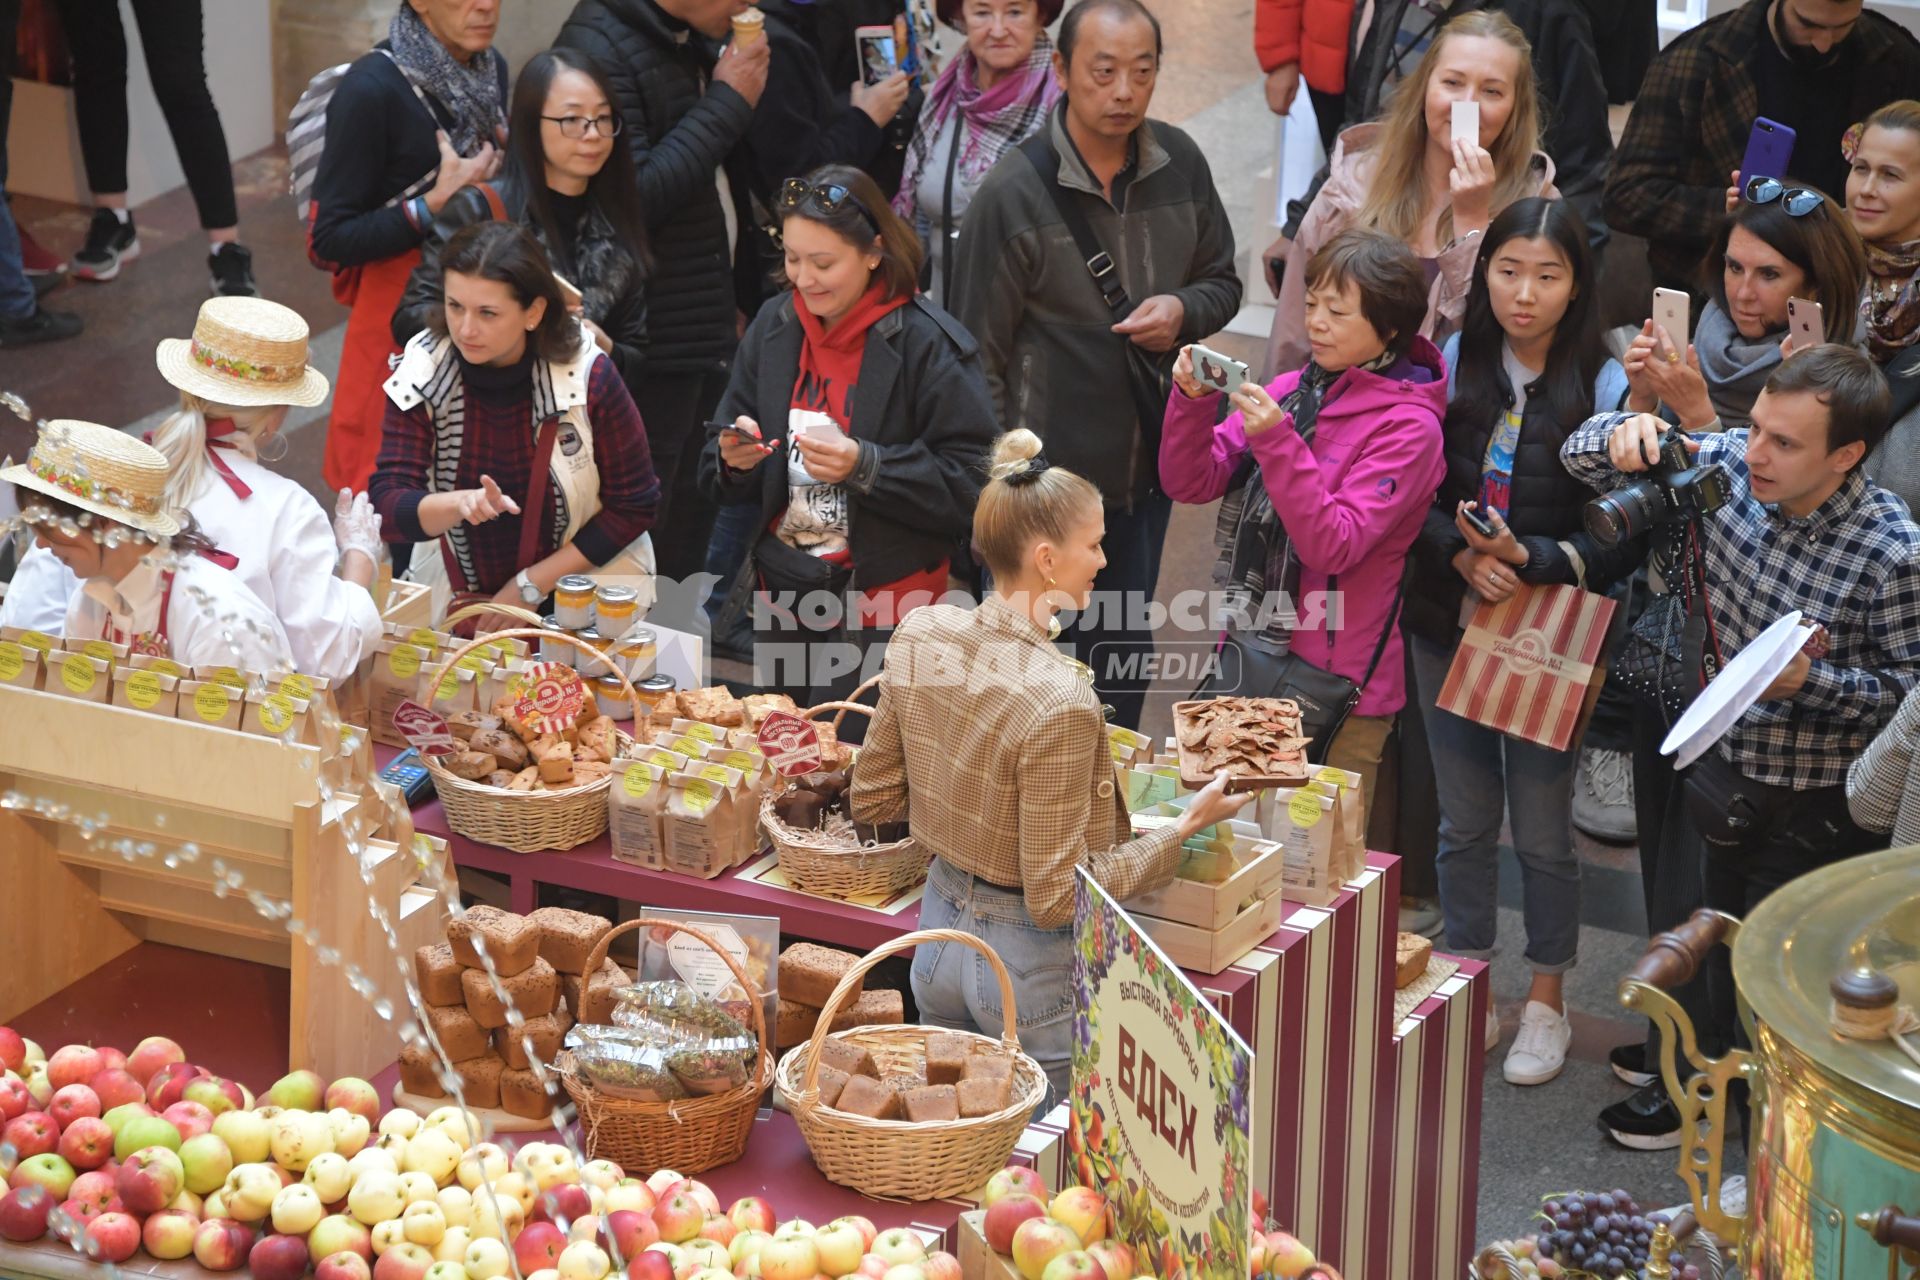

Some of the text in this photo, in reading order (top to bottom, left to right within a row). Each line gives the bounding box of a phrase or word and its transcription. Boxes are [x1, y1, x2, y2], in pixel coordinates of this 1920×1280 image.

[1703, 653, 1716, 682] Can
[1119, 980, 1200, 1085] ВЫСТАВКА ЯРМАРКА
[1105, 1077, 1210, 1219] ДОСТИЖЕНИЙ СЕЛЬСКОГО ХОЗЯЙСТВА
[1118, 1022, 1198, 1175] ВДСХ
